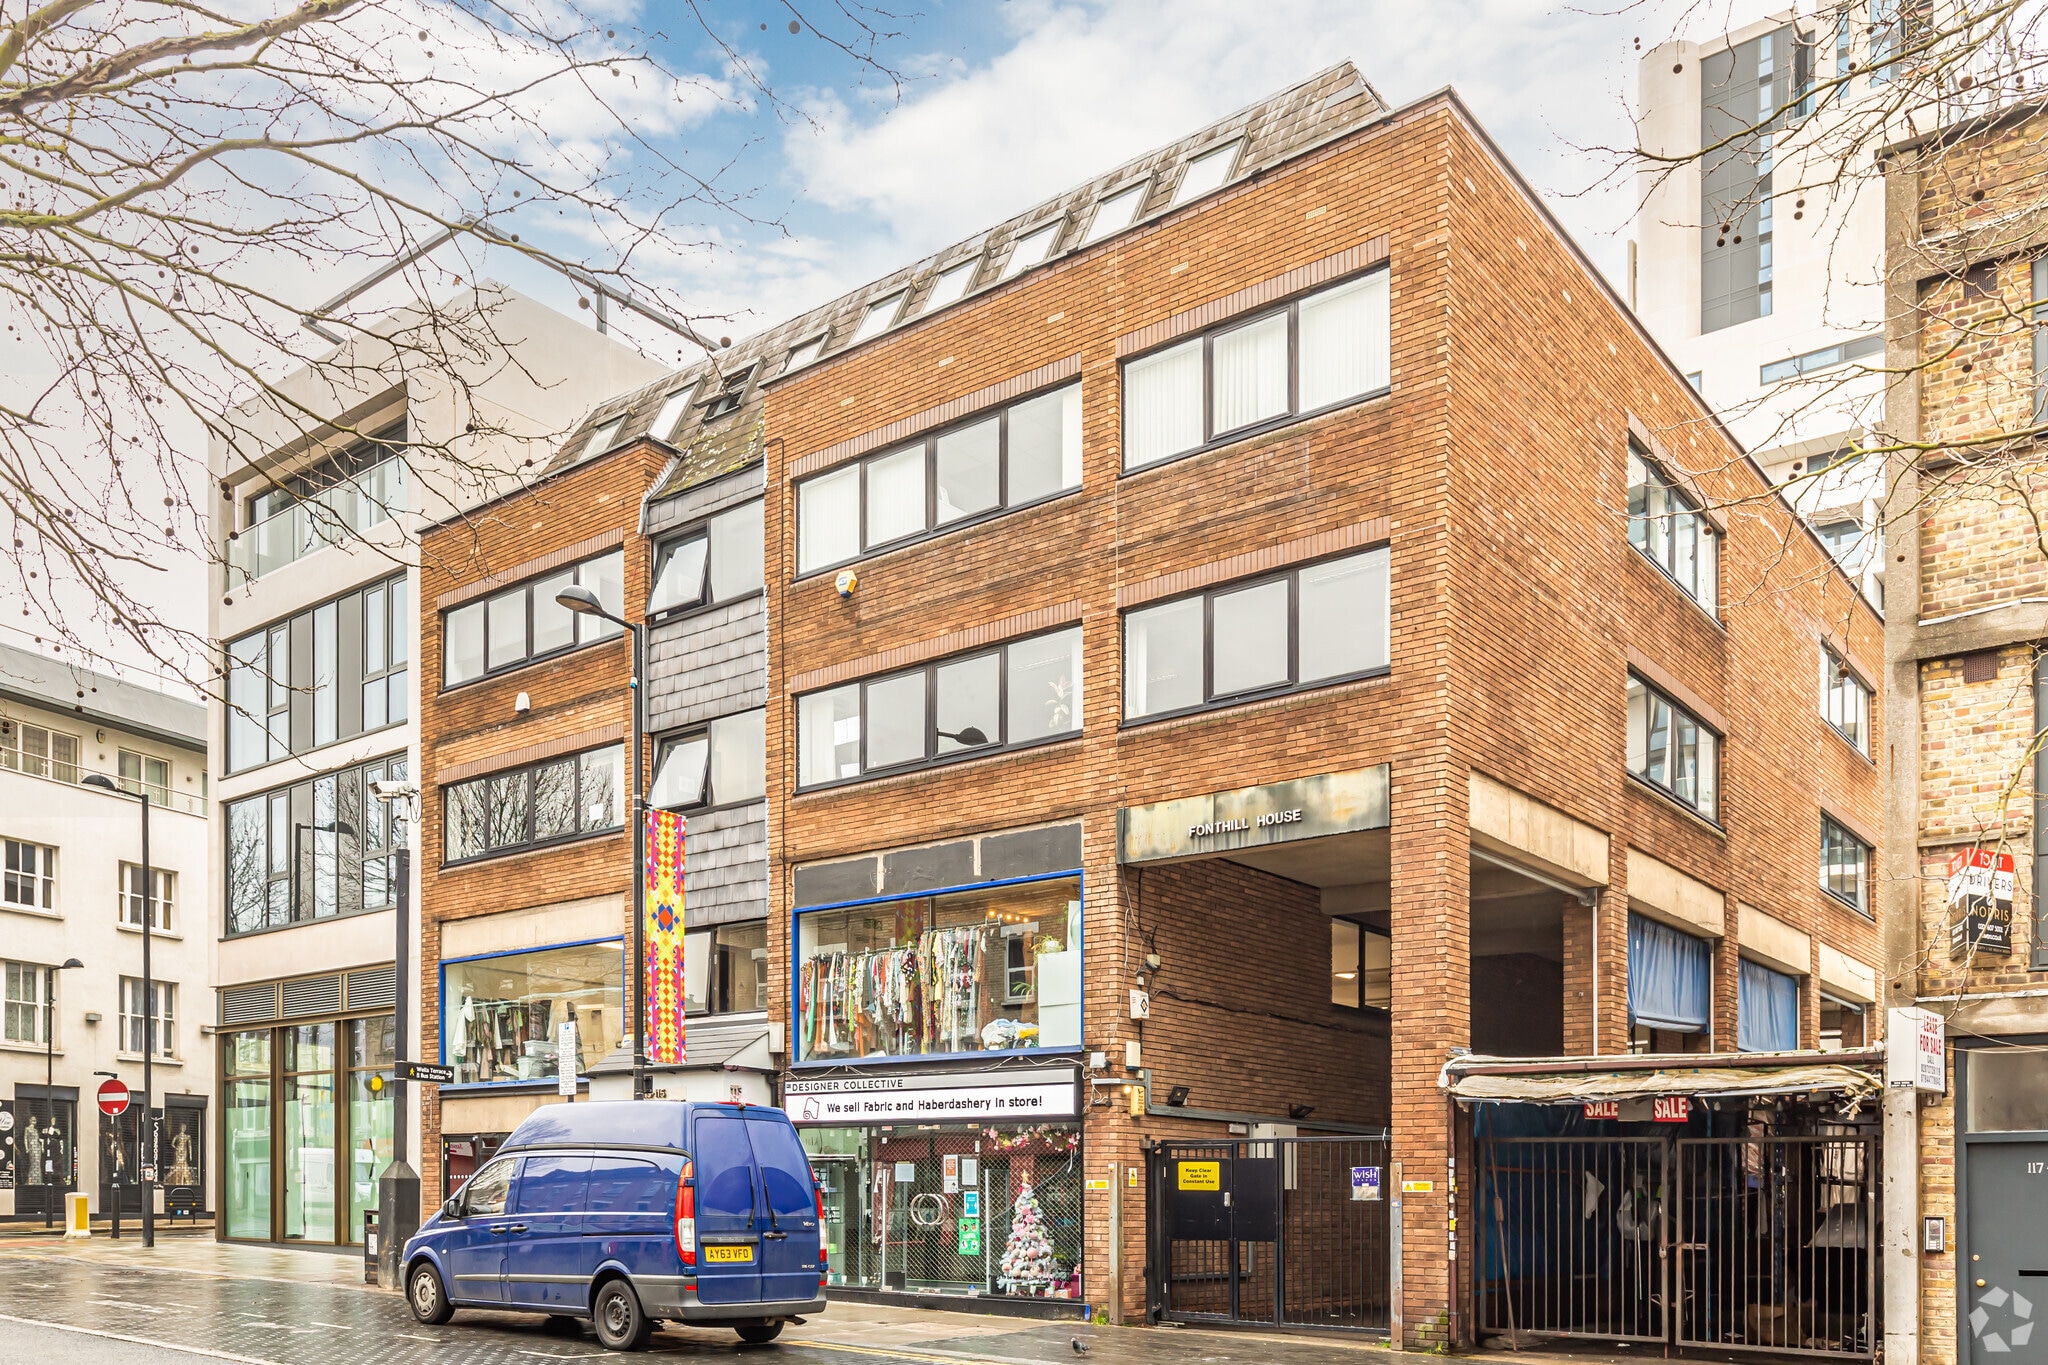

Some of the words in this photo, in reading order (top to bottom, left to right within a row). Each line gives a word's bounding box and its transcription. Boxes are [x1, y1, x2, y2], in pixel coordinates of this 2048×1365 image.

[1188, 817, 1250, 838] FONTHILL
[1256, 808, 1302, 827] HOUSE
[1923, 1014, 1938, 1035] LEASE
[1919, 1033, 1930, 1053] FOR
[1930, 1036, 1942, 1056] SALE
[792, 1081, 840, 1092] DESIGNER
[843, 1079, 904, 1090] COLLECTIVE
[827, 1103, 841, 1113] We
[843, 1101, 860, 1113] sell
[864, 1101, 893, 1112] Fabric
[895, 1099, 914, 1111] and
[918, 1097, 991, 1111] Haberdashery
[1008, 1095, 1042, 1107] store!
[1586, 1101, 1619, 1117] SALE
[1654, 1097, 1687, 1119] SALE
[2027, 1162, 2044, 1174] 117
[709, 1249, 731, 1259] AY63
